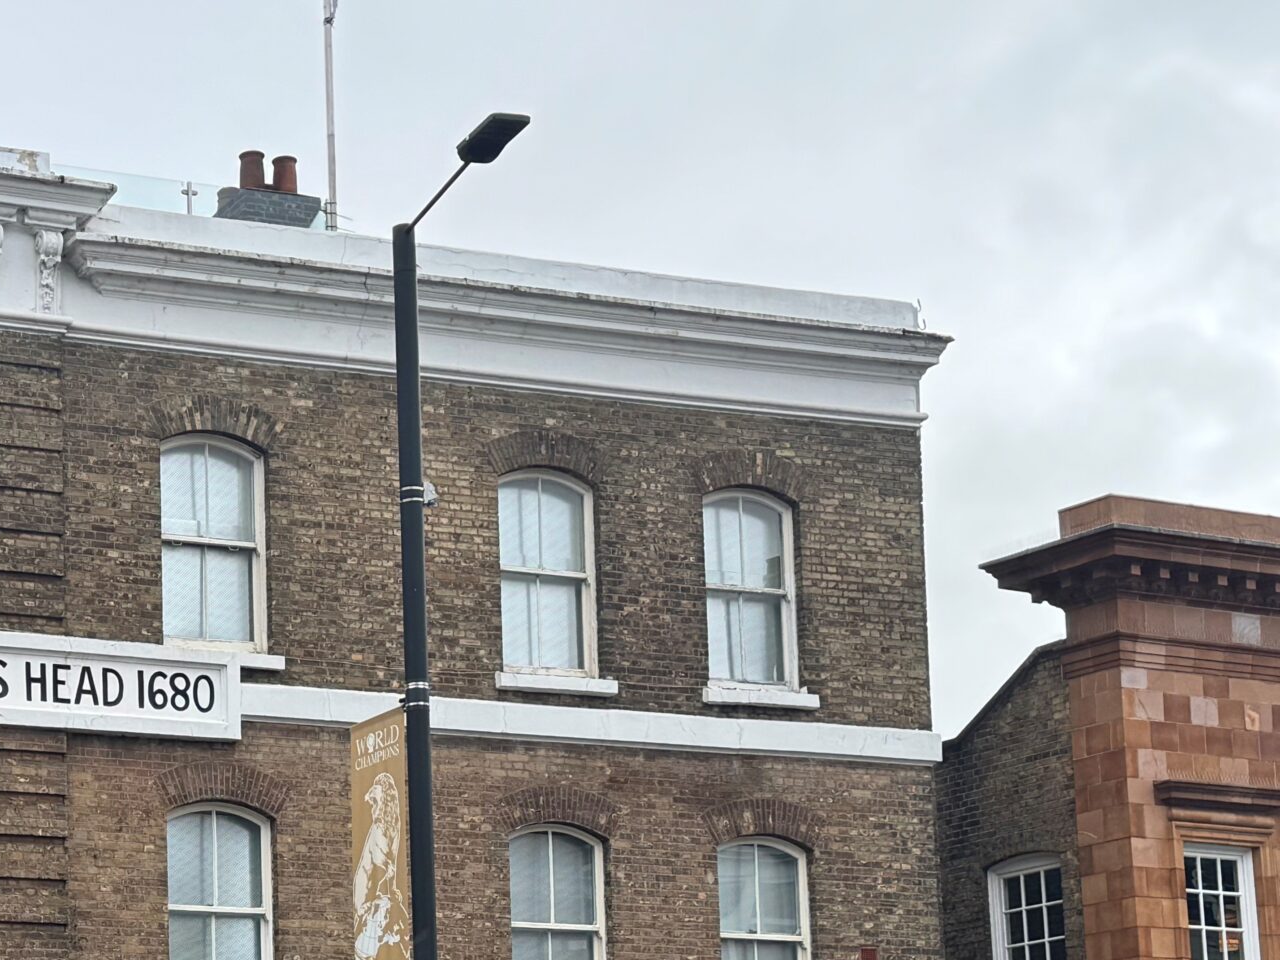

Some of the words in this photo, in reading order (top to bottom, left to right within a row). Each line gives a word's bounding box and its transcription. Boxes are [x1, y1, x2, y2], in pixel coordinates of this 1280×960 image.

[25, 661, 124, 707] HEAD
[137, 670, 215, 713] 1680
[356, 724, 399, 756] WORLD
[355, 743, 400, 771] CHAMPIONS
